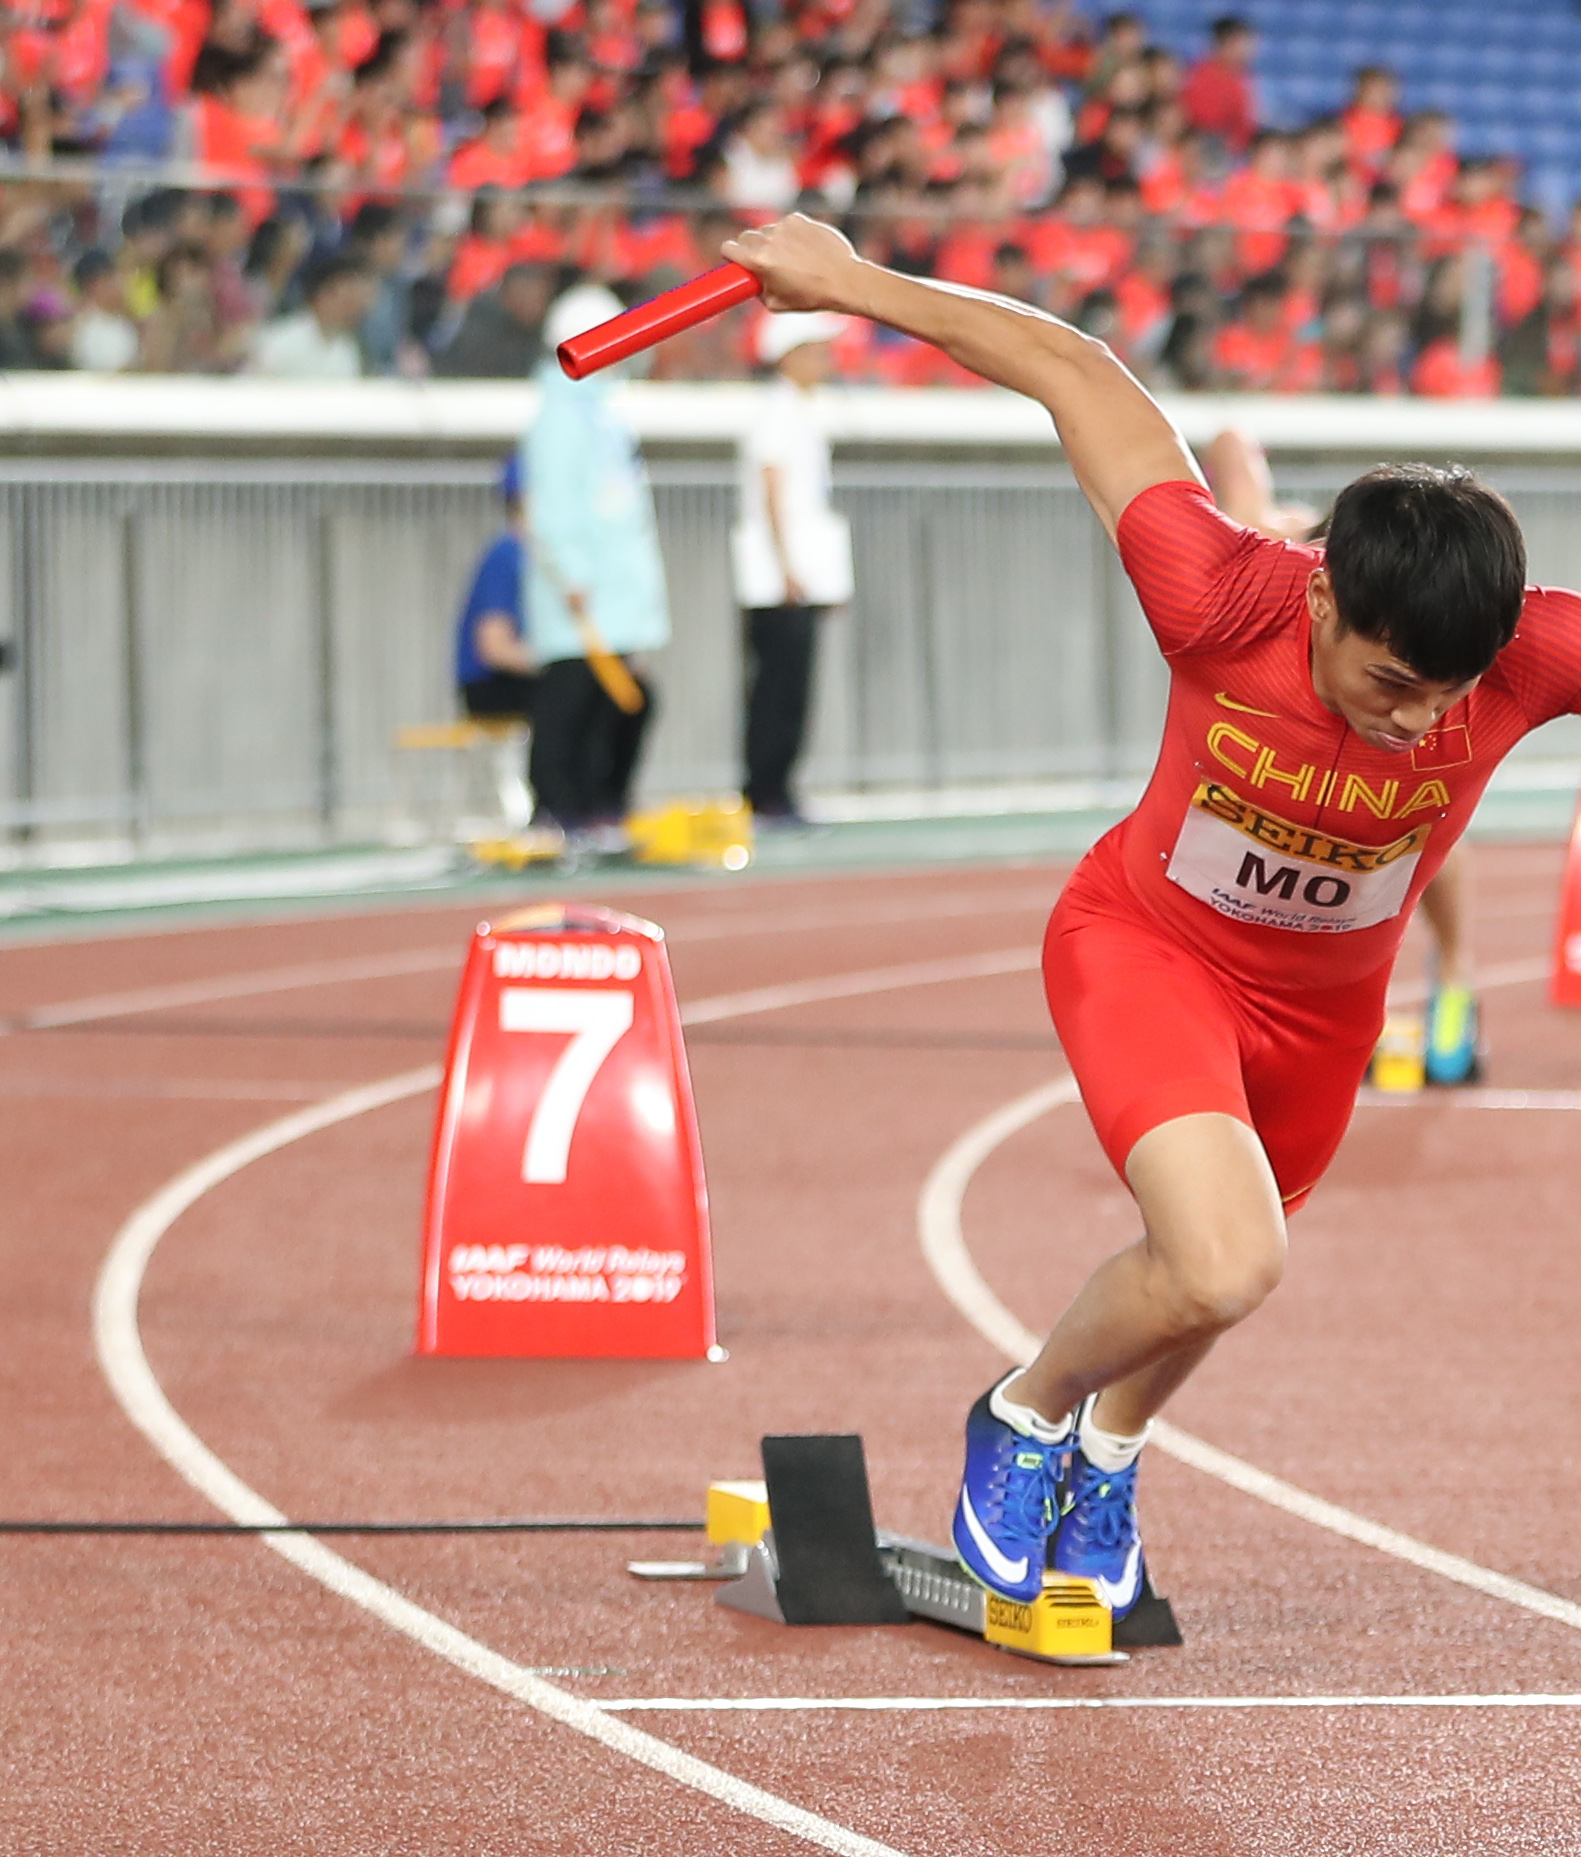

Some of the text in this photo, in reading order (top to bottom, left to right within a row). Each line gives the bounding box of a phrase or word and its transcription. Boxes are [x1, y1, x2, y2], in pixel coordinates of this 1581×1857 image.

[1206, 721, 1450, 819] CHINA
[1203, 784, 1417, 870] SEIKO
[1235, 851, 1351, 908] MO
[1210, 896, 1304, 930] YOKOHAMA
[1211, 888, 1257, 909] IAAF
[1261, 908, 1305, 922] World
[494, 943, 642, 980] MONDO
[500, 989, 635, 1184] 7
[449, 1244, 531, 1273] IAAF
[531, 1244, 606, 1273] World
[449, 1273, 610, 1303] YOKOHAMA
[989, 1596, 1032, 1634] SEIKO
